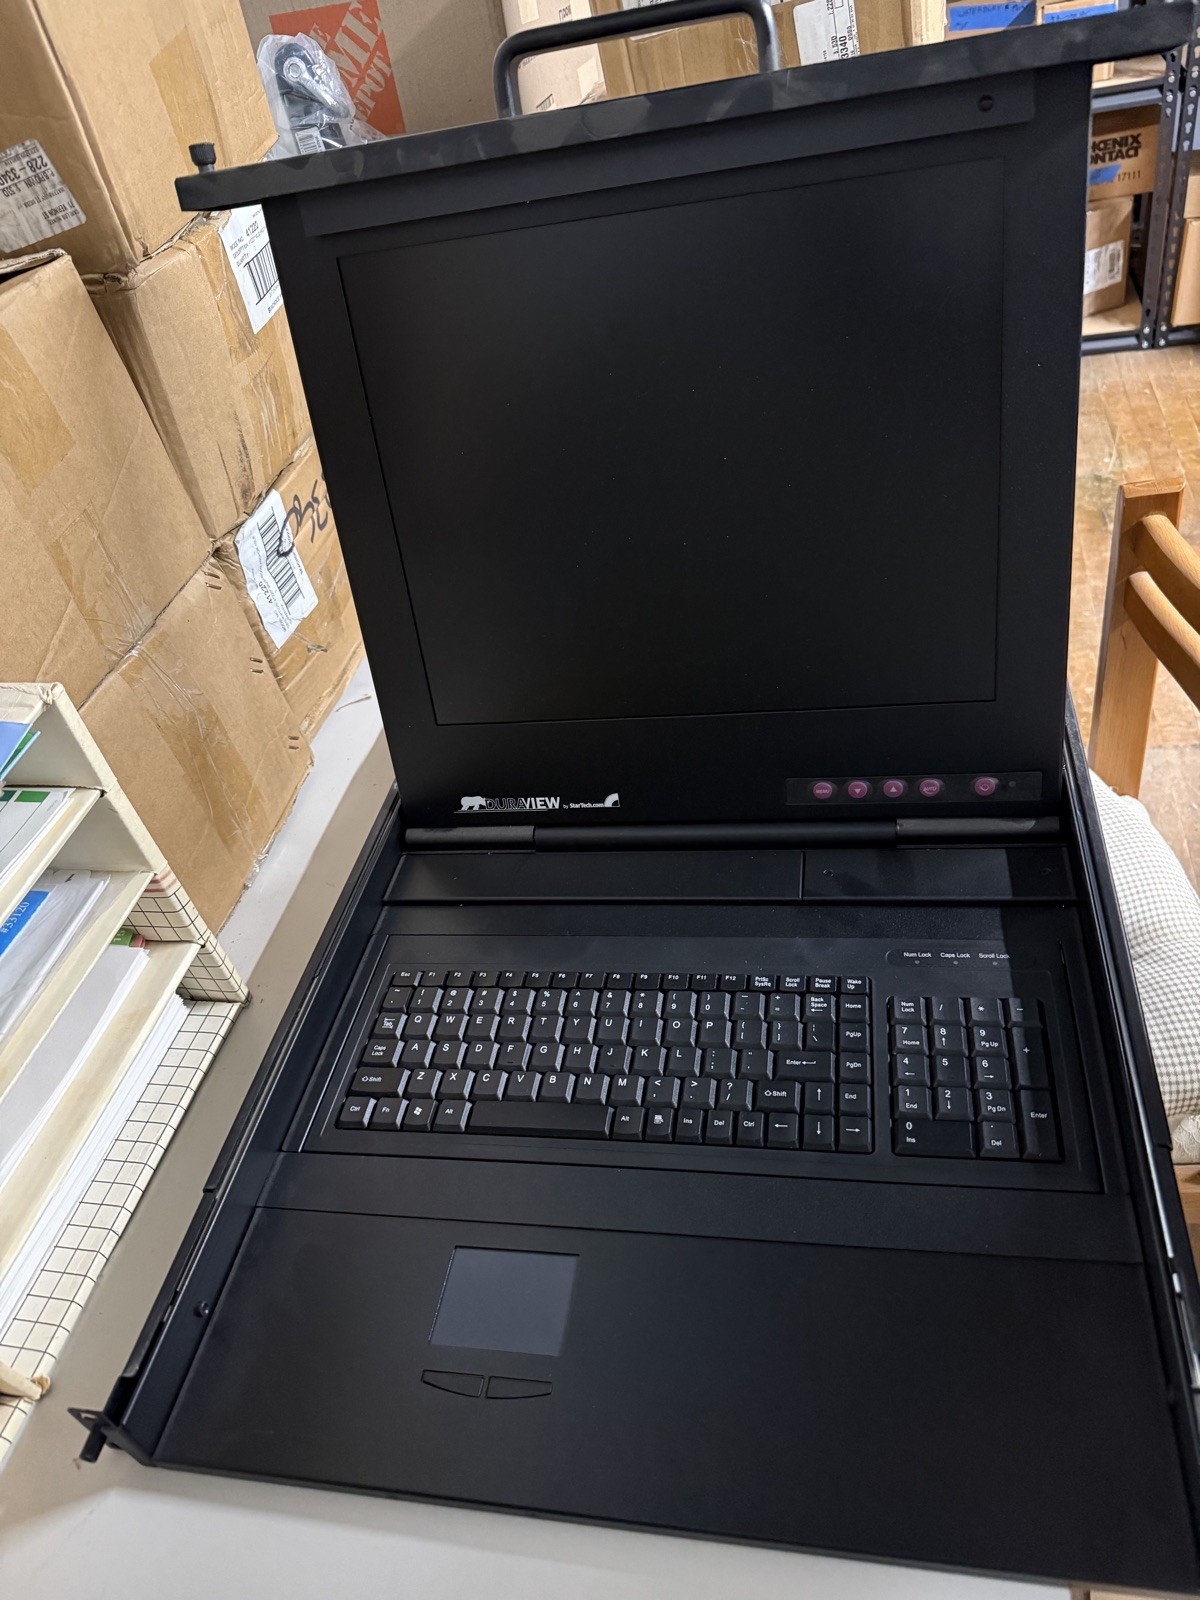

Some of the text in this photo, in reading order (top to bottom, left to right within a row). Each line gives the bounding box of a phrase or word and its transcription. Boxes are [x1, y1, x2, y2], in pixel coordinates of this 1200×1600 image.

[352, 50, 391, 121] EPOT
[1090, 147, 1139, 165] NTACT
[26, 155, 48, 173] 228
[485, 796, 560, 810] DURAVIEW
[1, 901, 30, 933] #33120
[979, 952, 994, 960] Scroll
[414, 1015, 422, 1024] Q
[573, 1018, 580, 1026] Y
[672, 1021, 681, 1029] O
[979, 1029, 985, 1037] 9
[443, 1044, 449, 1052] S
[540, 1045, 548, 1053] G
[573, 1046, 581, 1054] H
[607, 1048, 613, 1056] J
[641, 1049, 649, 1057] K
[903, 1057, 909, 1065] 4
[942, 1058, 948, 1066] 5
[982, 1060, 988, 1068] 6
[417, 1072, 424, 1080] Z
[449, 1073, 457, 1081] X
[482, 1073, 490, 1082] C
[583, 1077, 592, 1085] N
[986, 1092, 992, 1100] 3
[906, 1122, 912, 1130] 0
